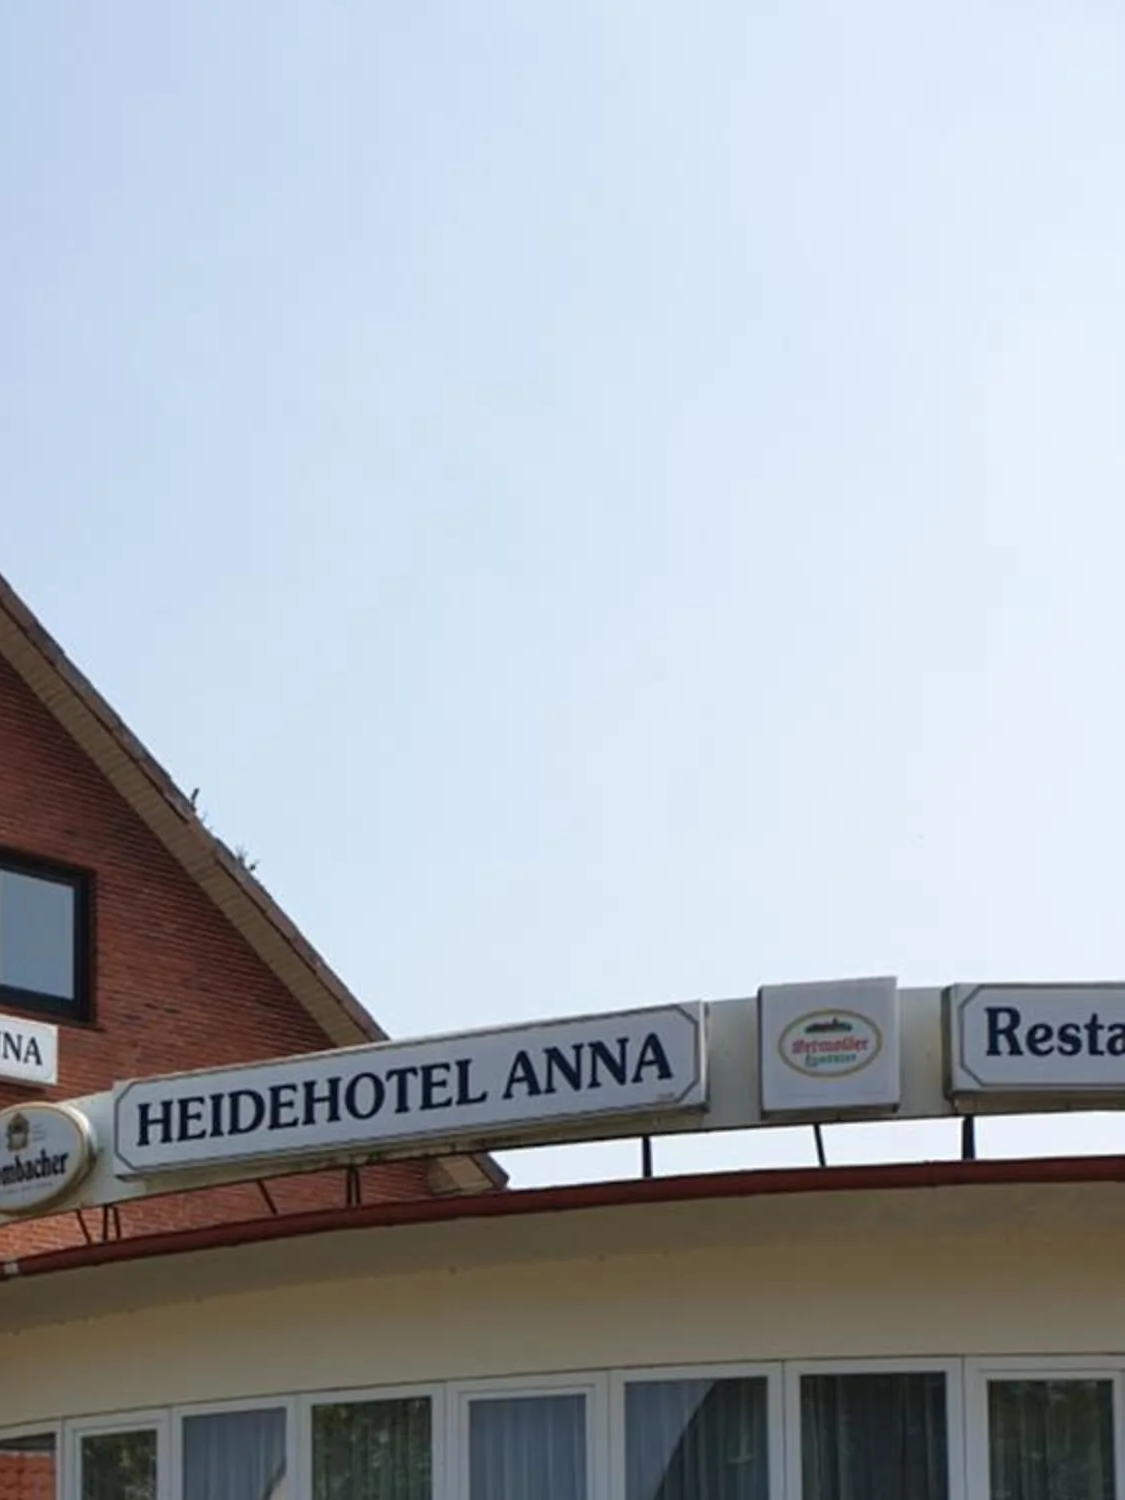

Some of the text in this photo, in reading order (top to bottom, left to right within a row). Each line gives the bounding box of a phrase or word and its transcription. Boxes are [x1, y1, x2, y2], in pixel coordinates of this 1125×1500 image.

[984, 1006, 1125, 1057] Resta
[135, 1031, 674, 1146] HEIDEHOTEL ANNA
